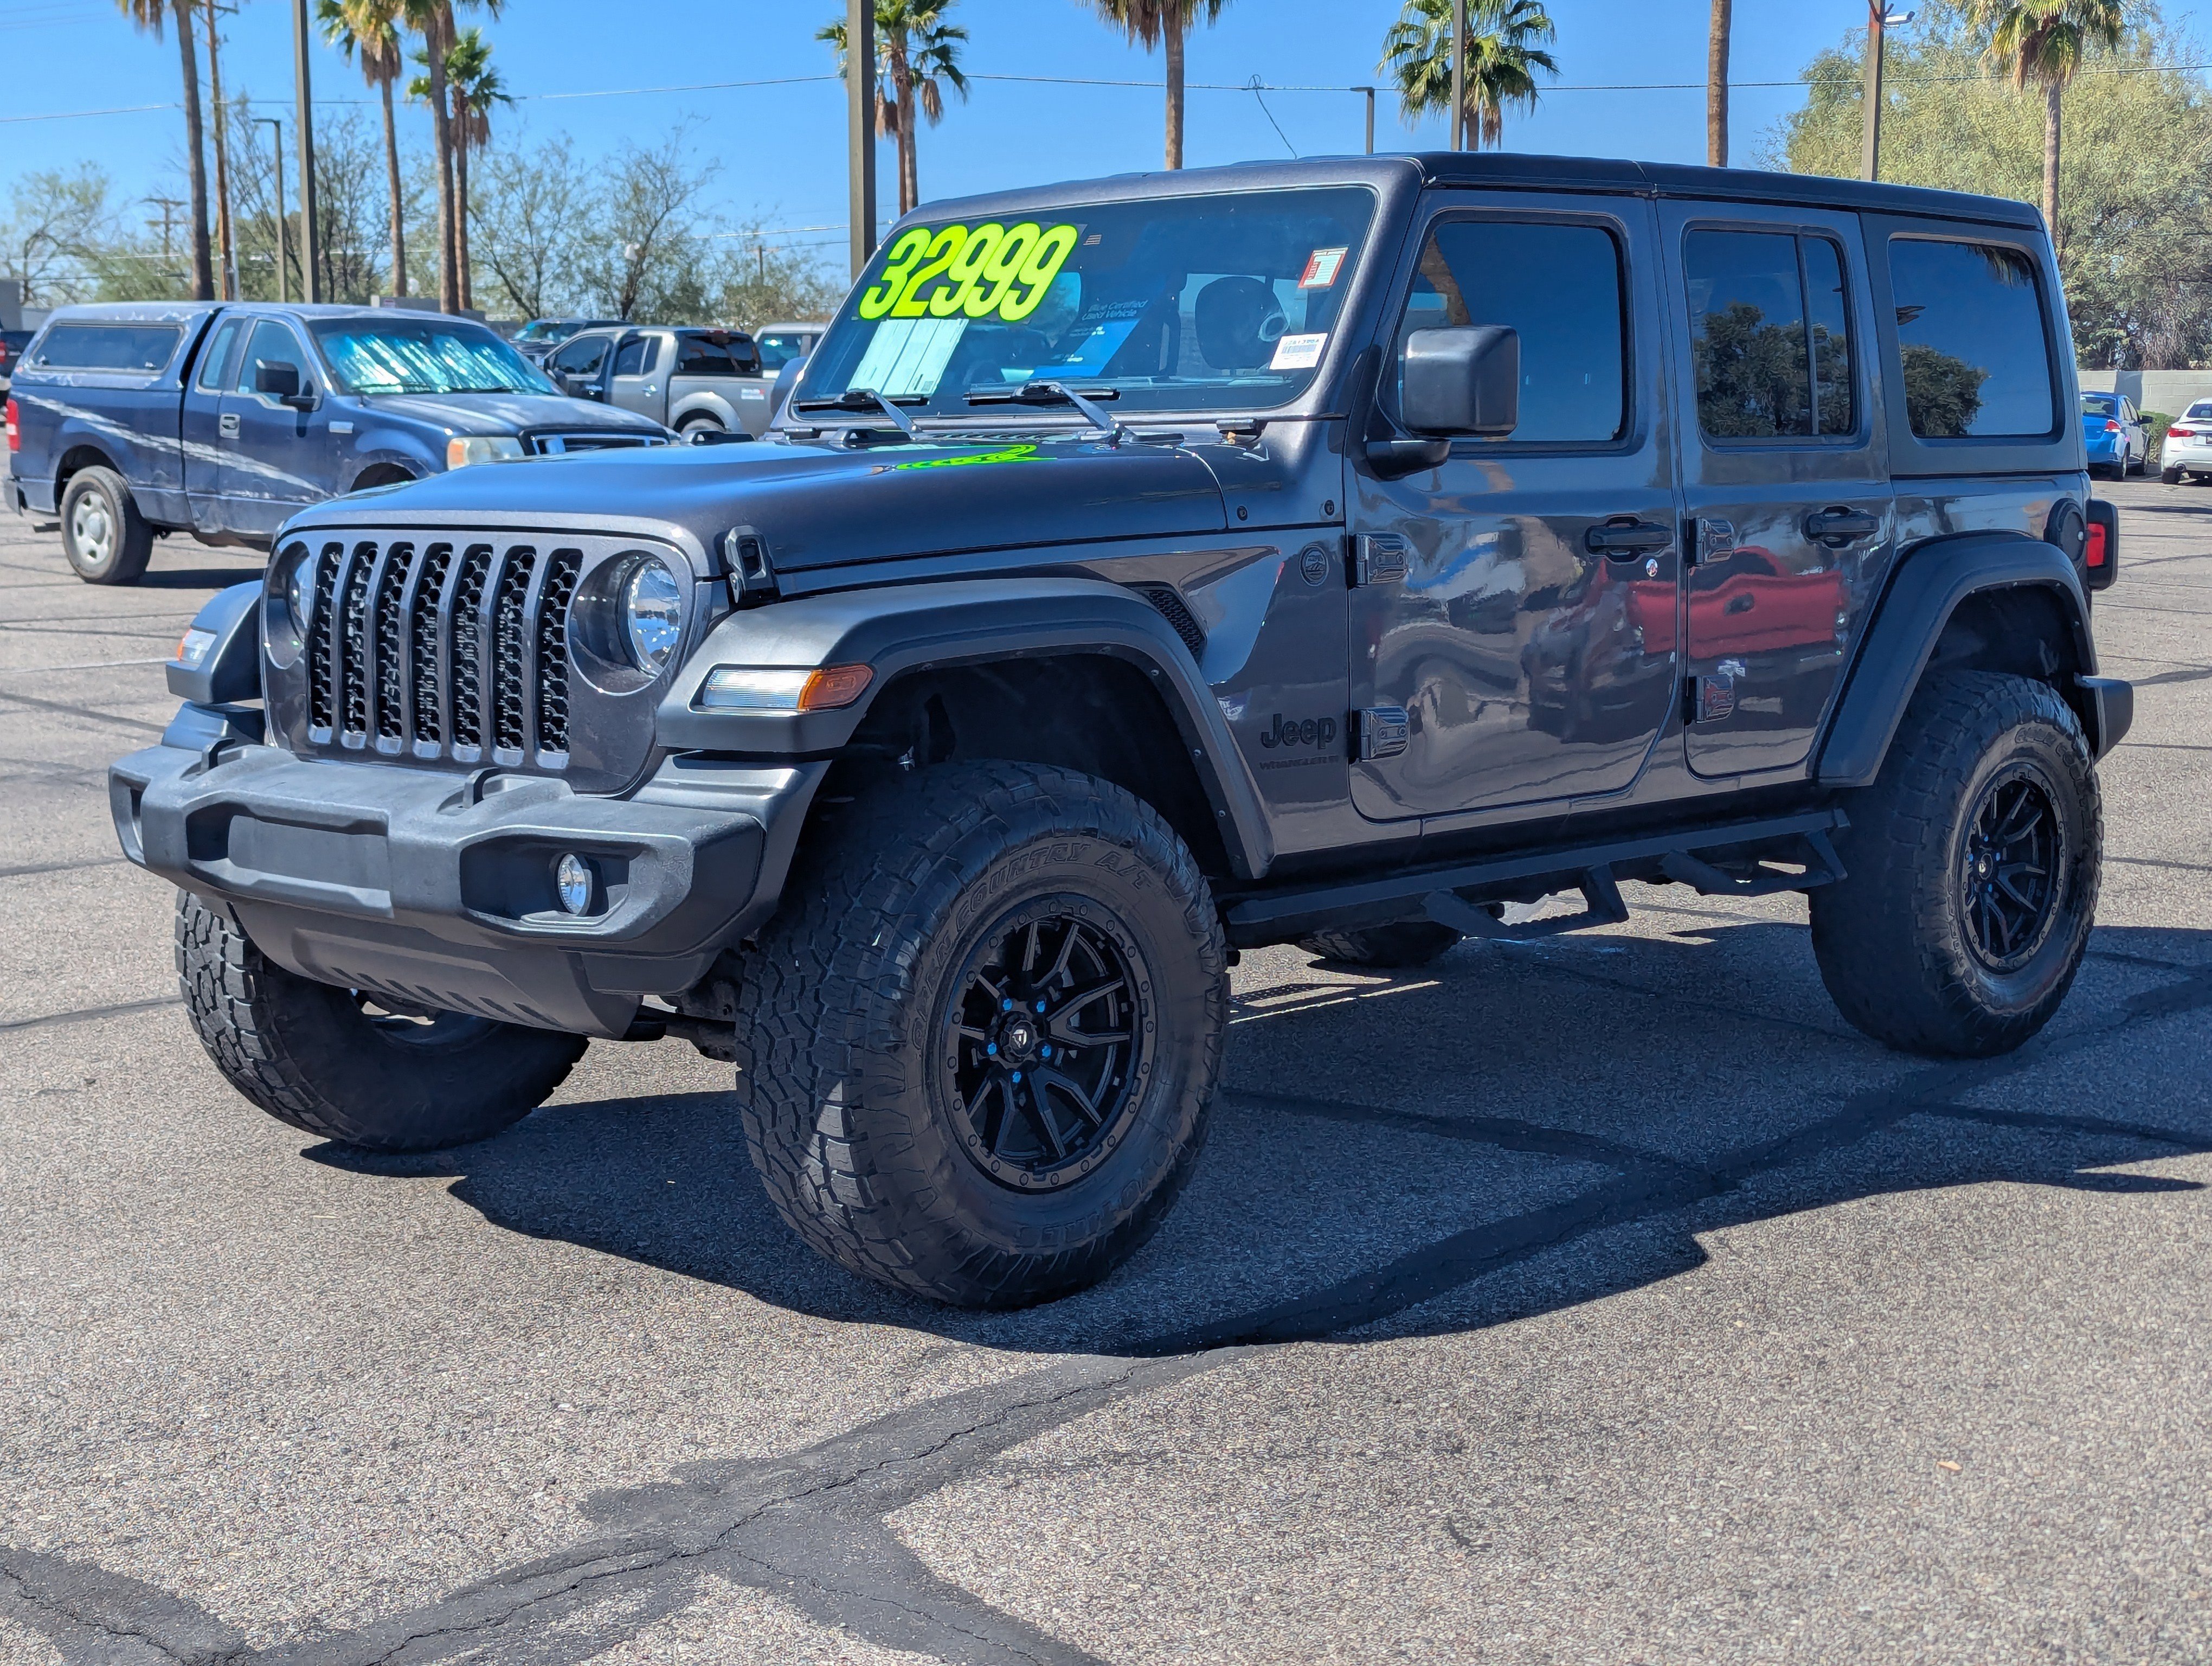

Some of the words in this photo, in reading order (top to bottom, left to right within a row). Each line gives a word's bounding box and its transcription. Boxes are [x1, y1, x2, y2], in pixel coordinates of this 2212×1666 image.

[859, 222, 1078, 322] 32999
[1261, 713, 1336, 749] Jeep
[956, 842, 1091, 932] COUNTRY
[1094, 850, 1154, 890] A/T
